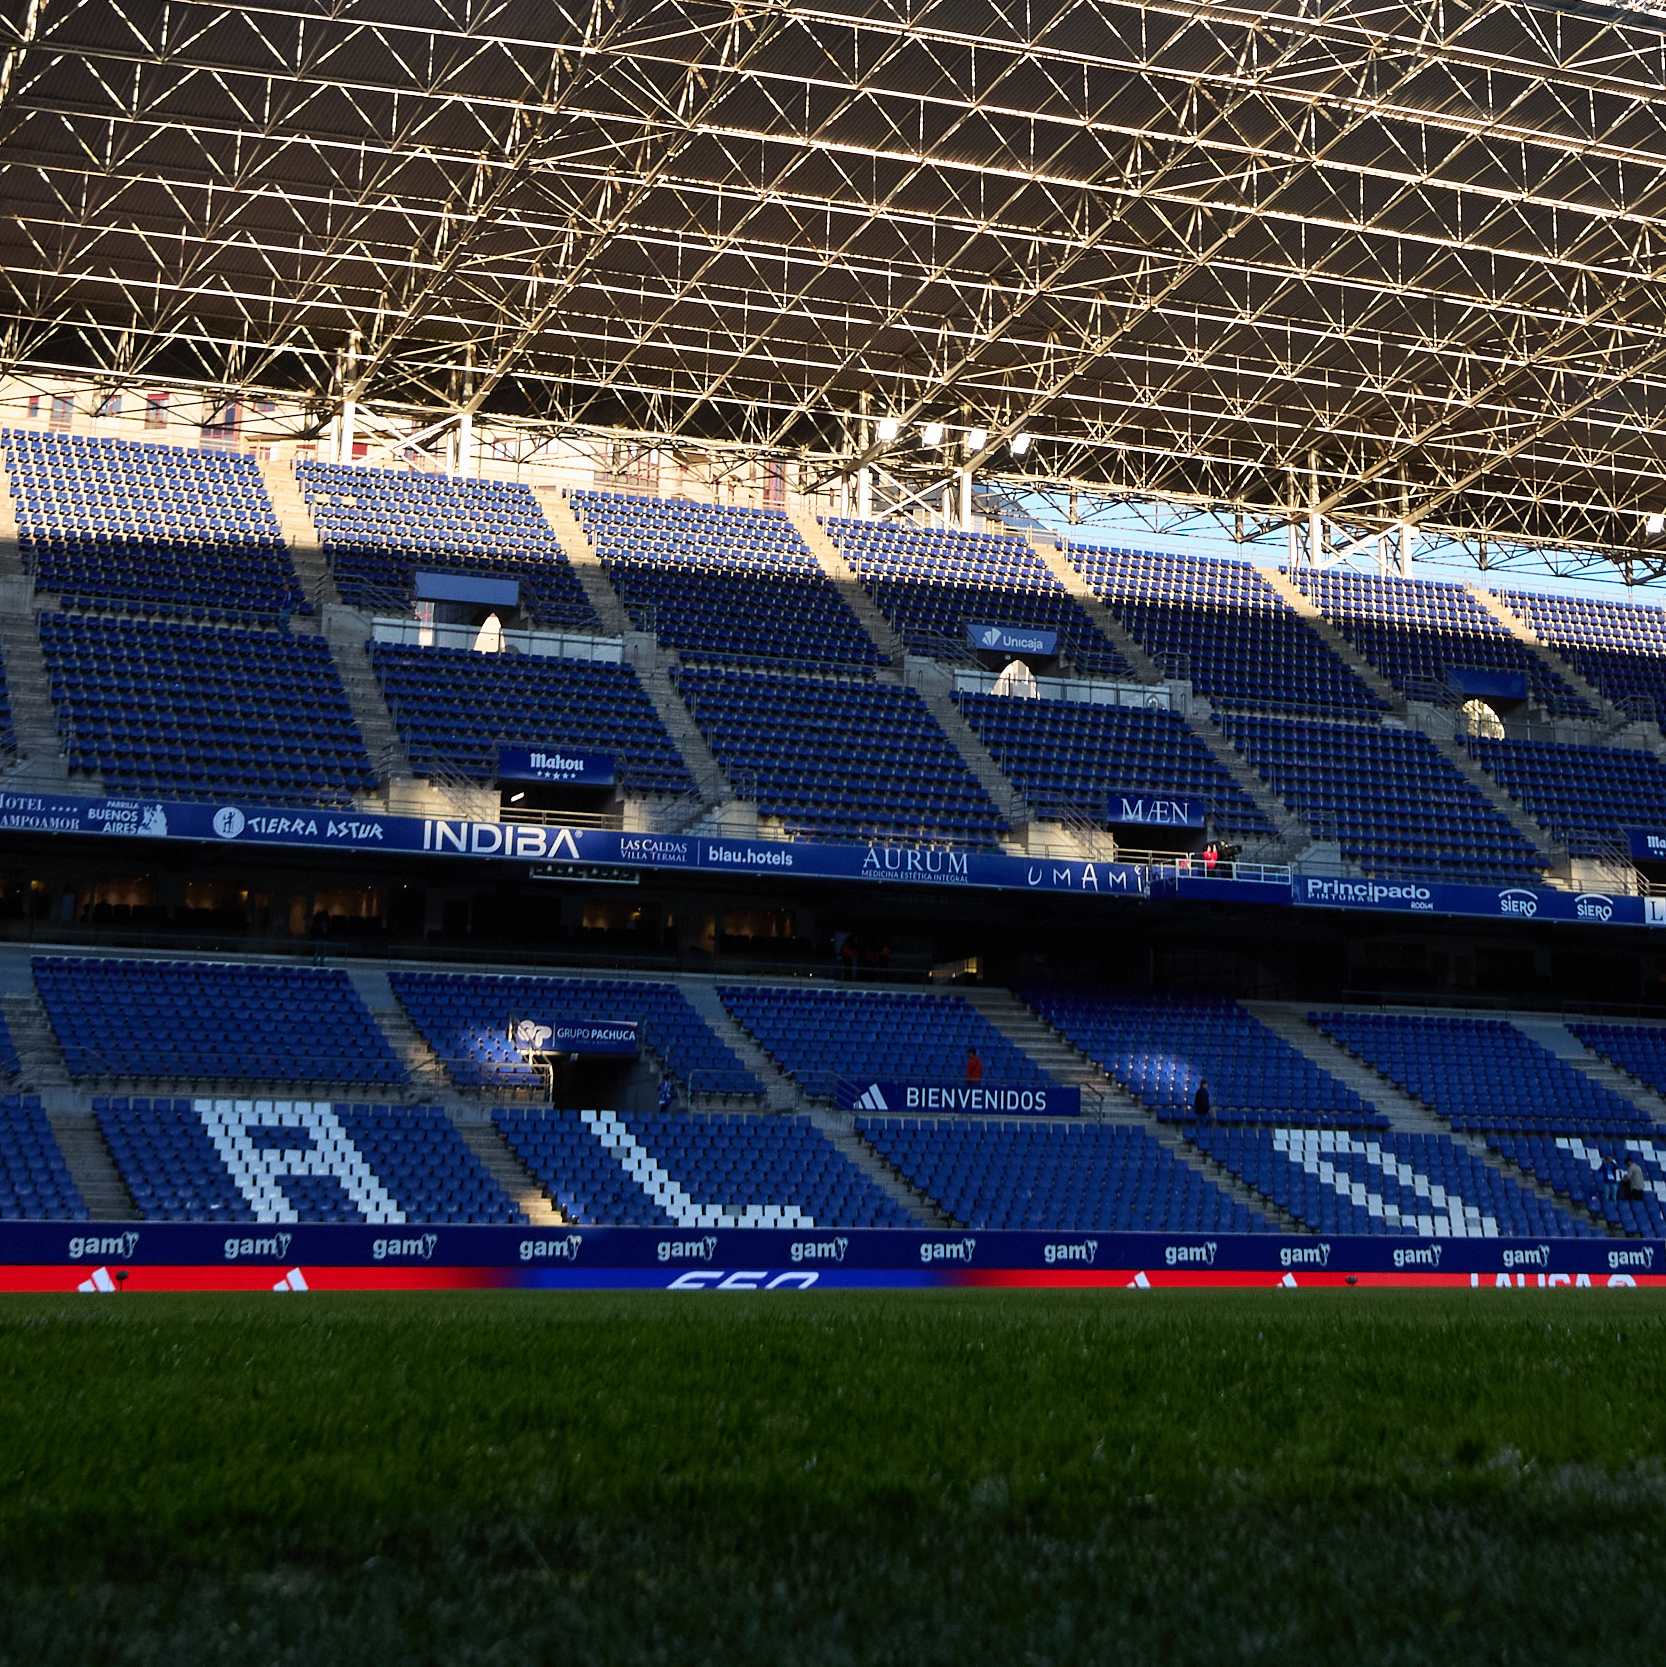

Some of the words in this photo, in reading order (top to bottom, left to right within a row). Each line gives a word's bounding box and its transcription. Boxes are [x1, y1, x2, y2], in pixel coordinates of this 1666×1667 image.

[1003, 635, 1043, 652] Unicaja
[530, 753, 584, 771] Mahou
[107, 801, 139, 810] PARRILLA
[88, 808, 138, 822] BUENOS
[102, 821, 137, 834] AIRES
[248, 817, 318, 836] TIERRA
[327, 819, 383, 840] ASTUR
[708, 845, 793, 867] blau.hotels
[863, 848, 968, 874] AURUM
[1308, 878, 1430, 902] Principado
[557, 1027, 590, 1039] GRUPO
[591, 1029, 635, 1041] PACHUCA
[906, 1086, 1047, 1111] BIENVENIDOS
